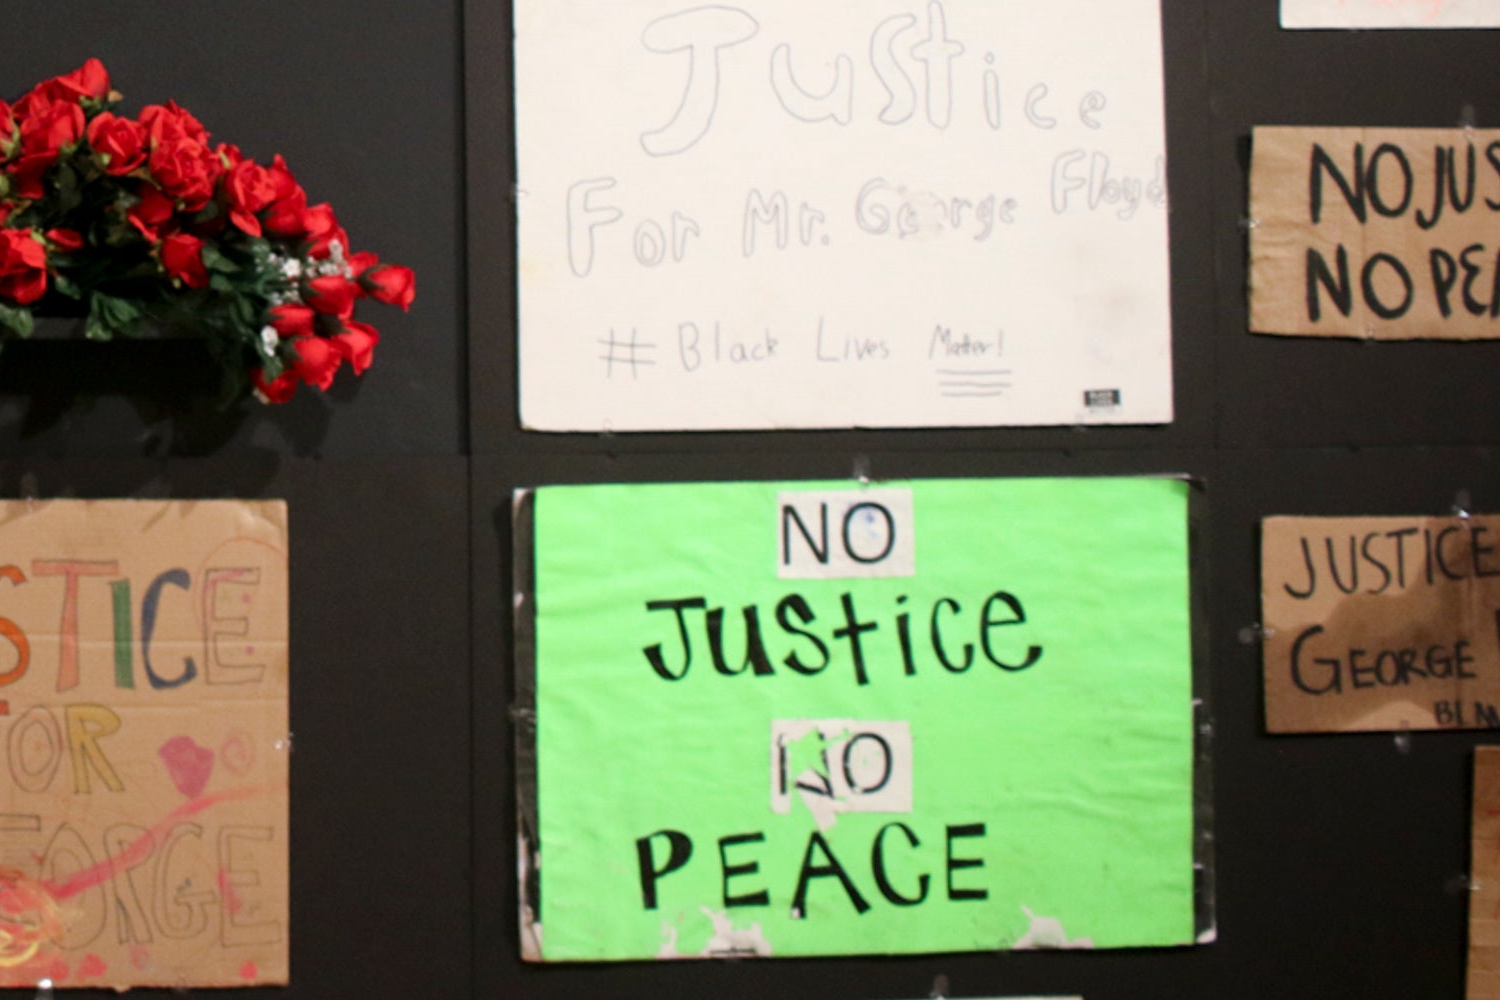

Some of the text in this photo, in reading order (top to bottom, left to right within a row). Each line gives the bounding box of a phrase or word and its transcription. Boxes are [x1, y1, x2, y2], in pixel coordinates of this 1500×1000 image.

[640, 0, 1106, 156] Justice
[566, 178, 699, 277] For
[743, 189, 830, 257] Mr.
[1051, 149, 1168, 222] Floyd
[1309, 141, 1414, 225] NO
[1306, 243, 1414, 323] NO
[816, 318, 889, 363] Lives
[781, 501, 896, 566] NO
[1284, 526, 1500, 599] JUSTICE
[642, 592, 1043, 685] Justice
[1290, 625, 1476, 695] GEORGE
[777, 732, 893, 798] NO
[636, 821, 989, 920] PEACE
